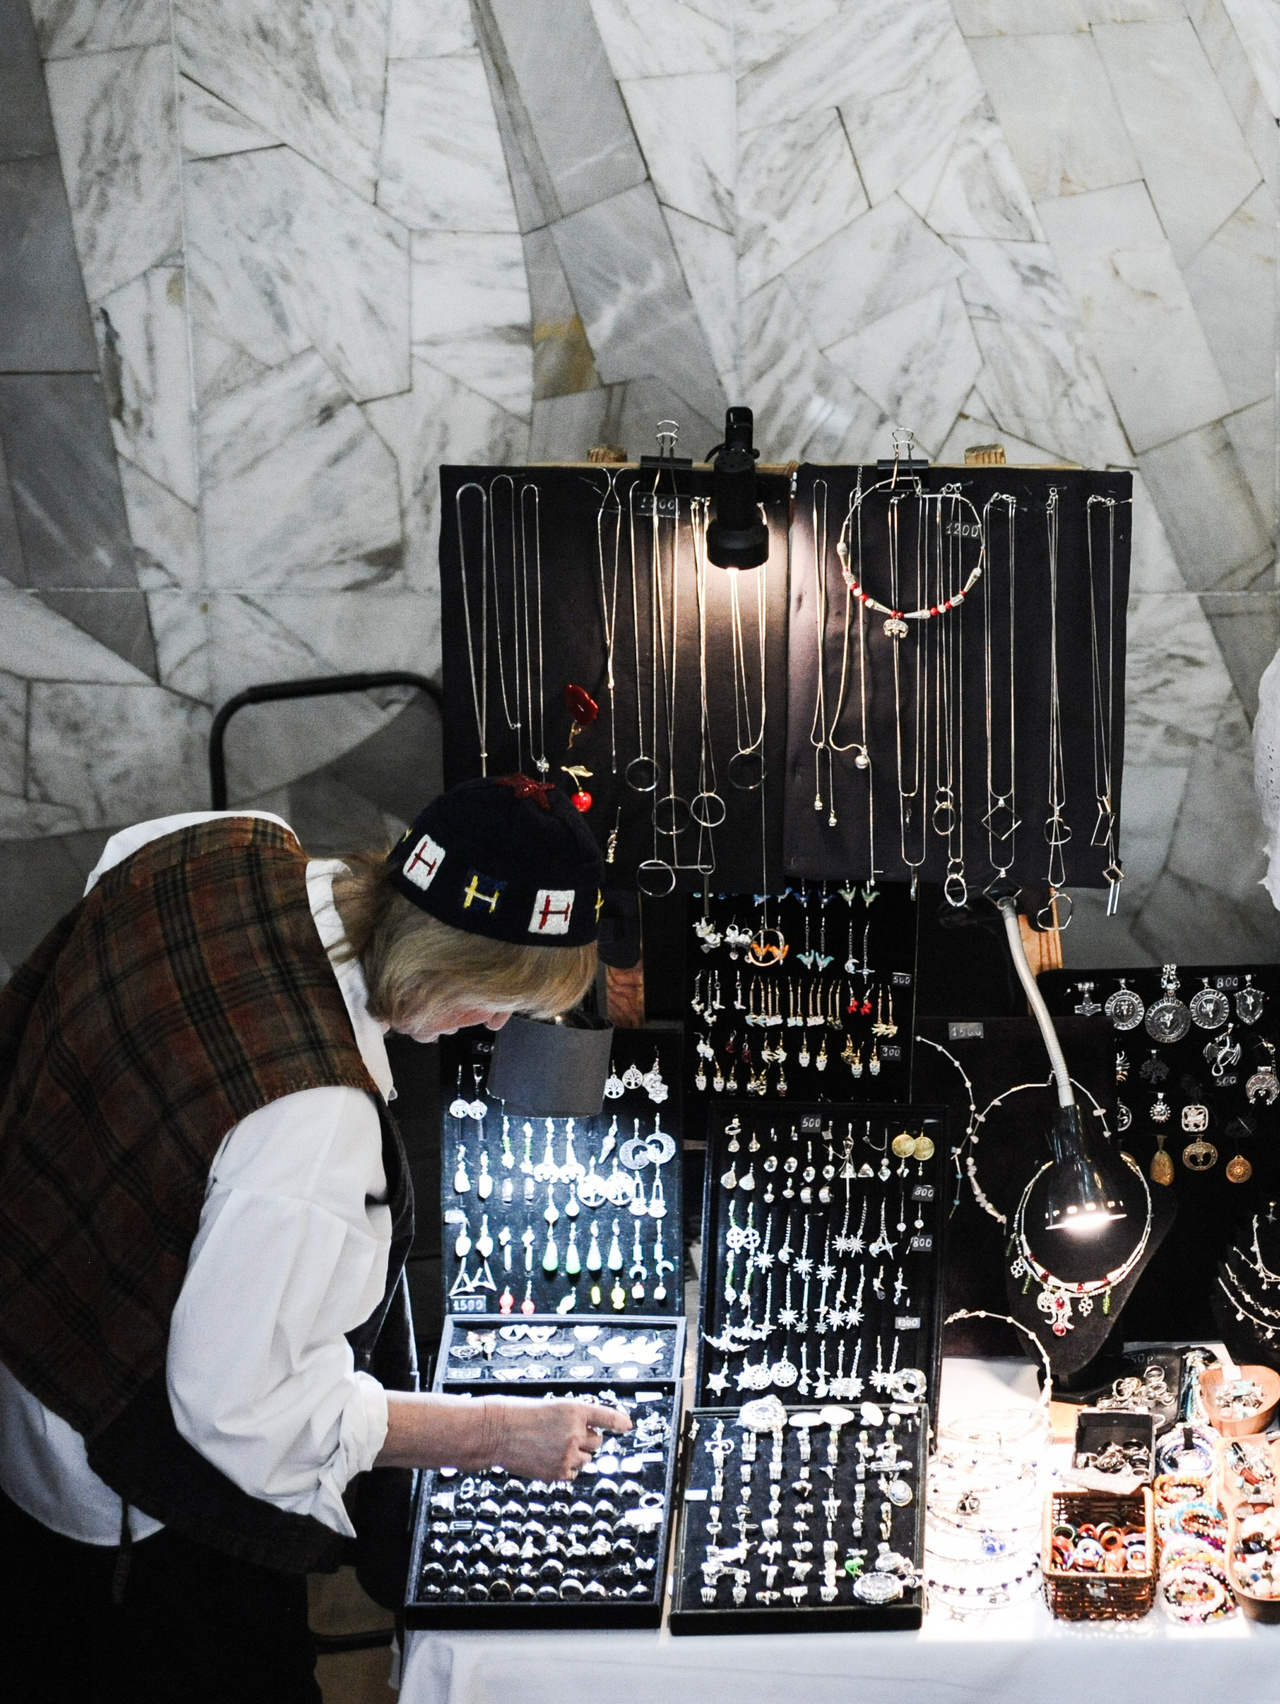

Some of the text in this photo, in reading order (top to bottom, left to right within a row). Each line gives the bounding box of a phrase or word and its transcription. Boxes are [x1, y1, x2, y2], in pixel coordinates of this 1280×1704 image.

[946, 522, 979, 537] 1200
[1216, 977, 1239, 989] 800
[882, 1047, 901, 1057] 300
[802, 1117, 821, 1128] 500
[453, 1299, 484, 1311] 1500
